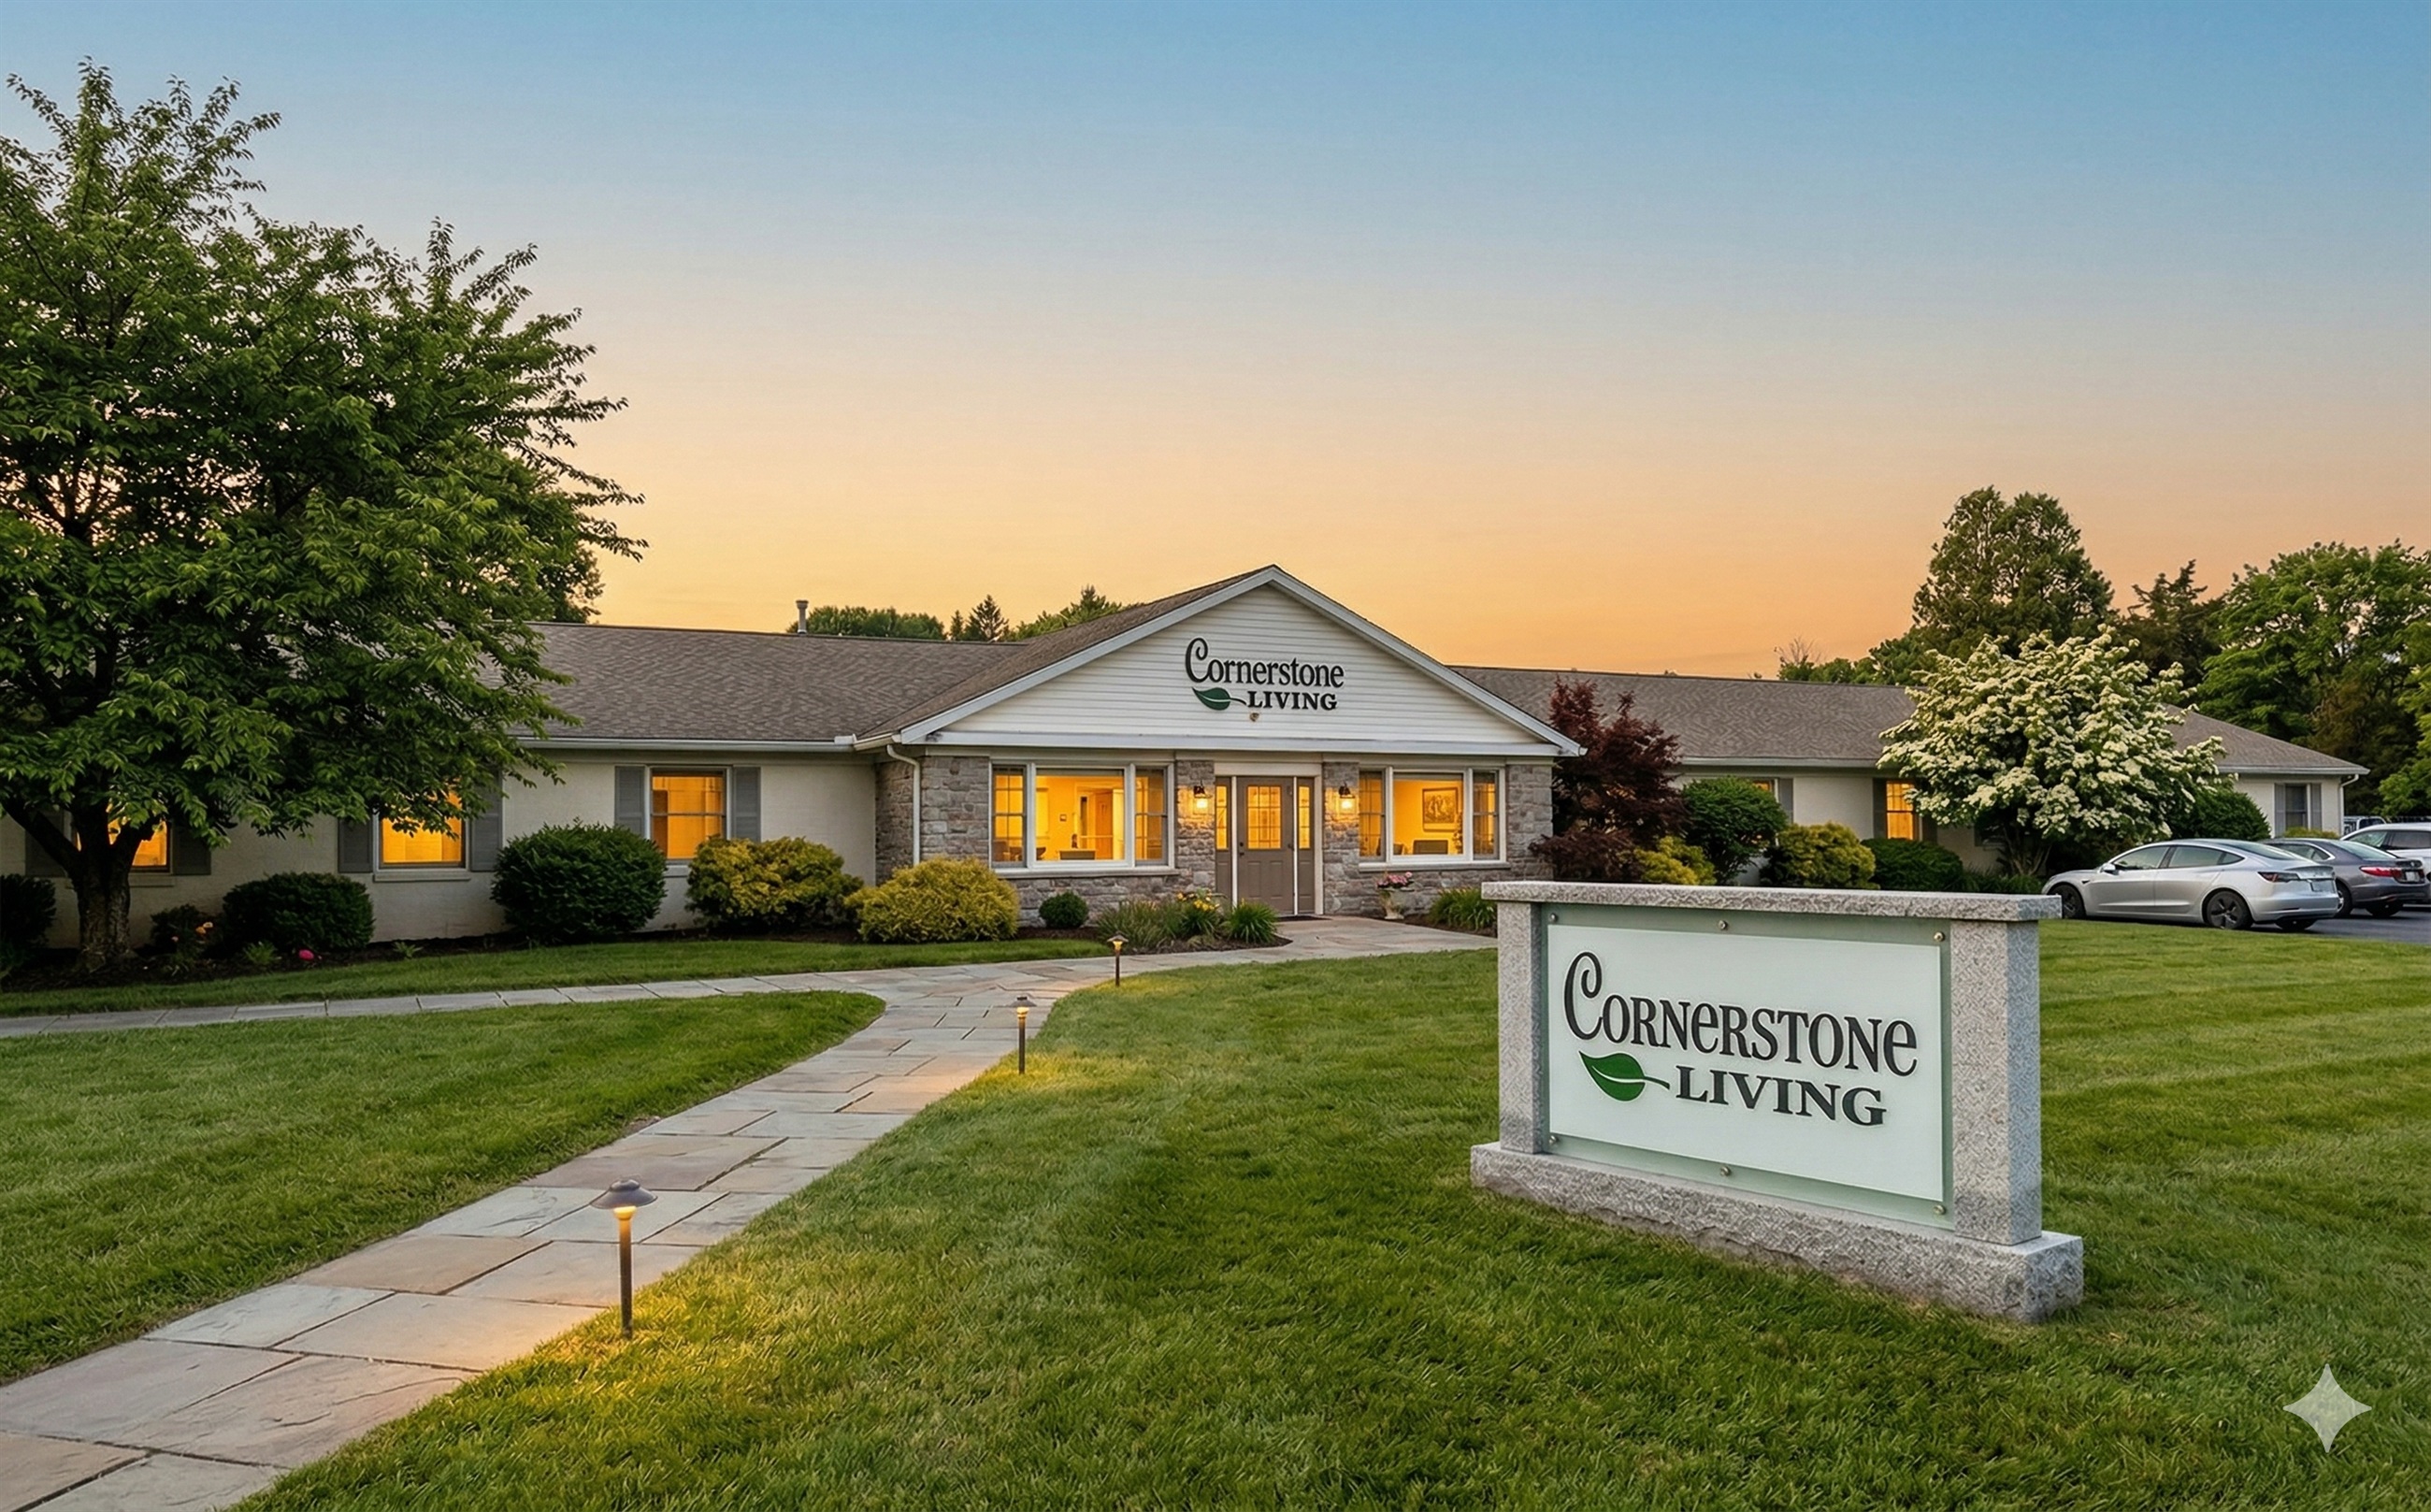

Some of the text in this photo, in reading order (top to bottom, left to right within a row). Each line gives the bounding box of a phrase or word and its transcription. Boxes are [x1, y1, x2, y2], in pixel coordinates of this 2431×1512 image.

[1185, 637, 1344, 688] Cornerstone
[1246, 690, 1338, 711] LIVING
[1675, 1065, 1887, 1126] LIVING
